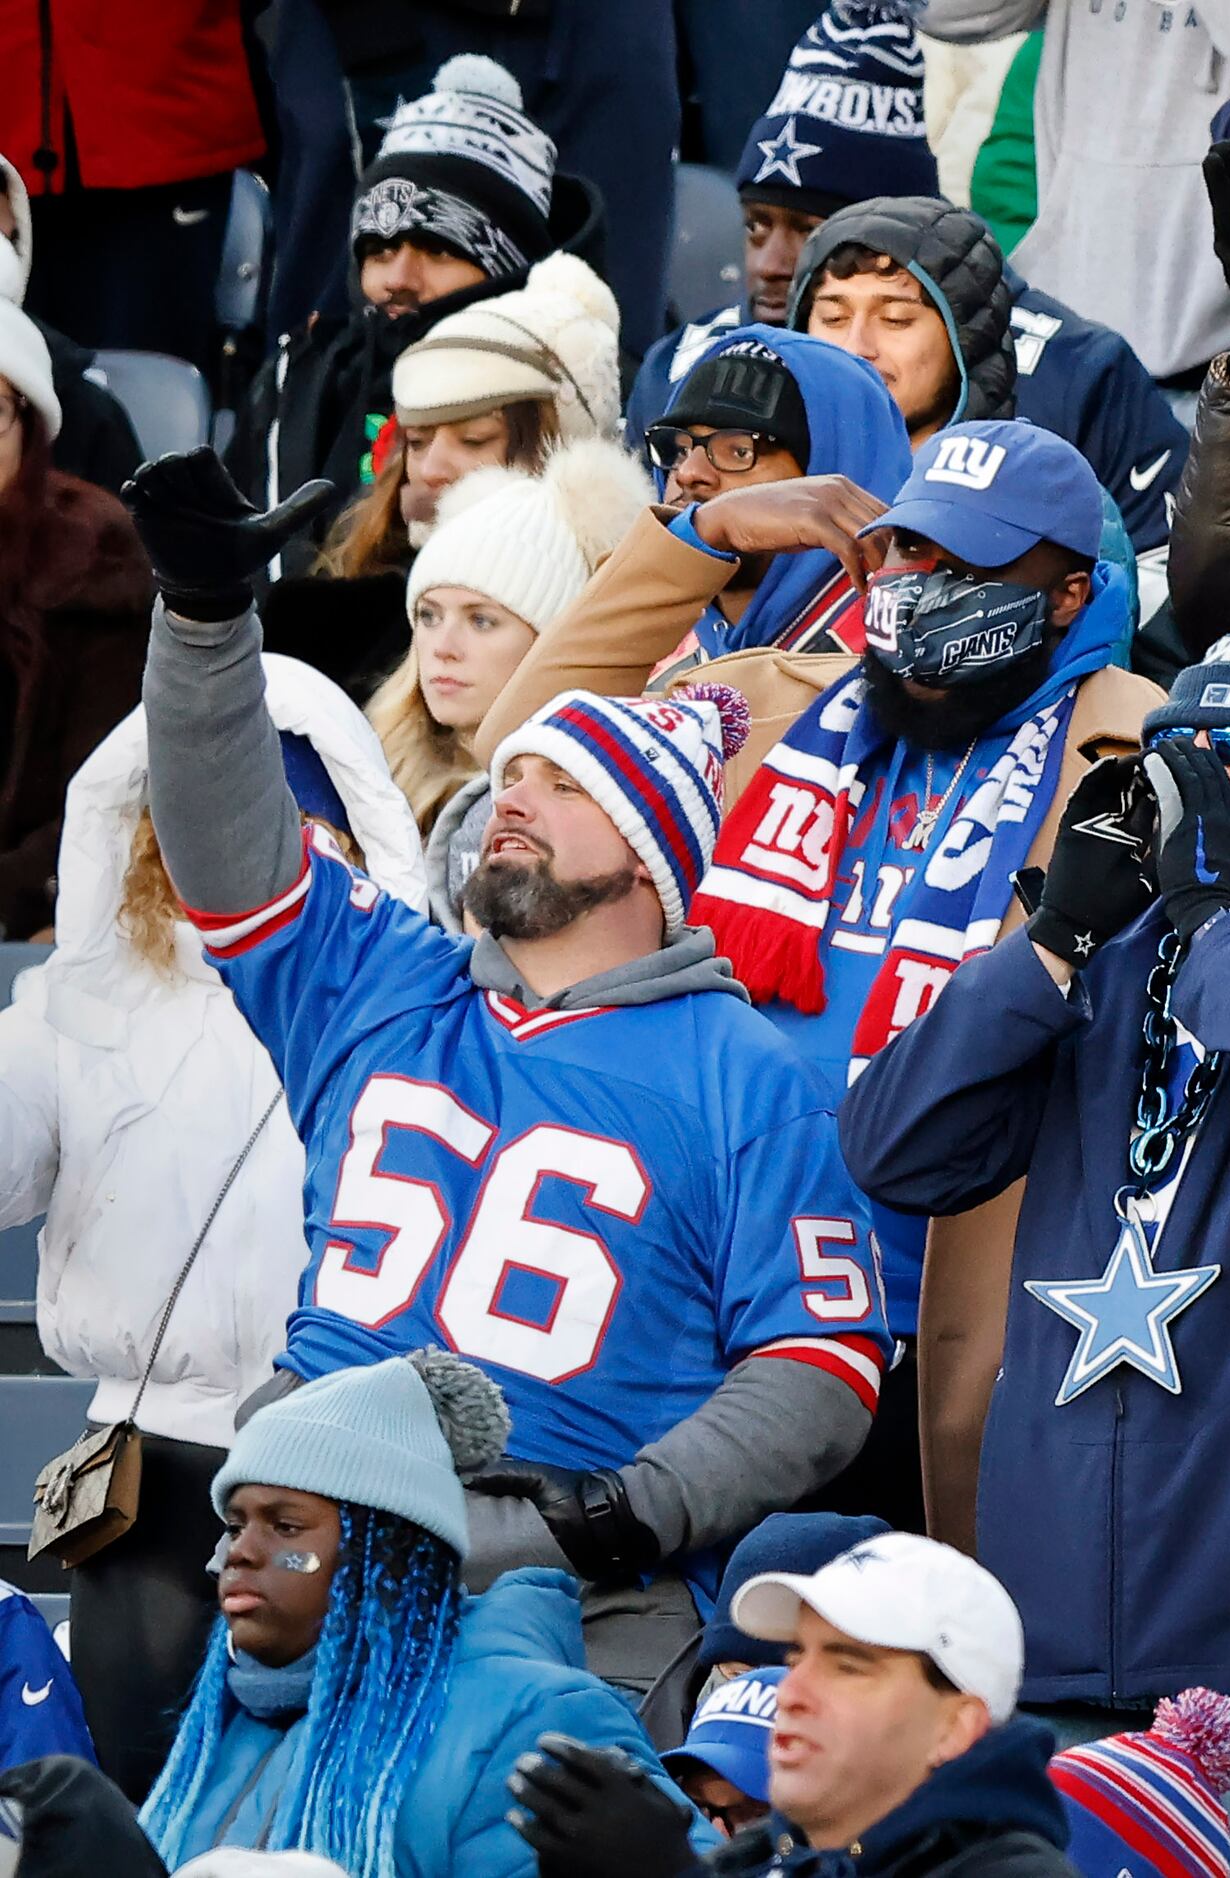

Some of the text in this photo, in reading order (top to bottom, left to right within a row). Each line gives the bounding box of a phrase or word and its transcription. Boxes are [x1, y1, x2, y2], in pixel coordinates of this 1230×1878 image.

[764, 70, 919, 134] WBOYS
[939, 622, 1018, 675] GIANTS
[314, 1072, 654, 1386] 56
[789, 1214, 890, 1330] 5
